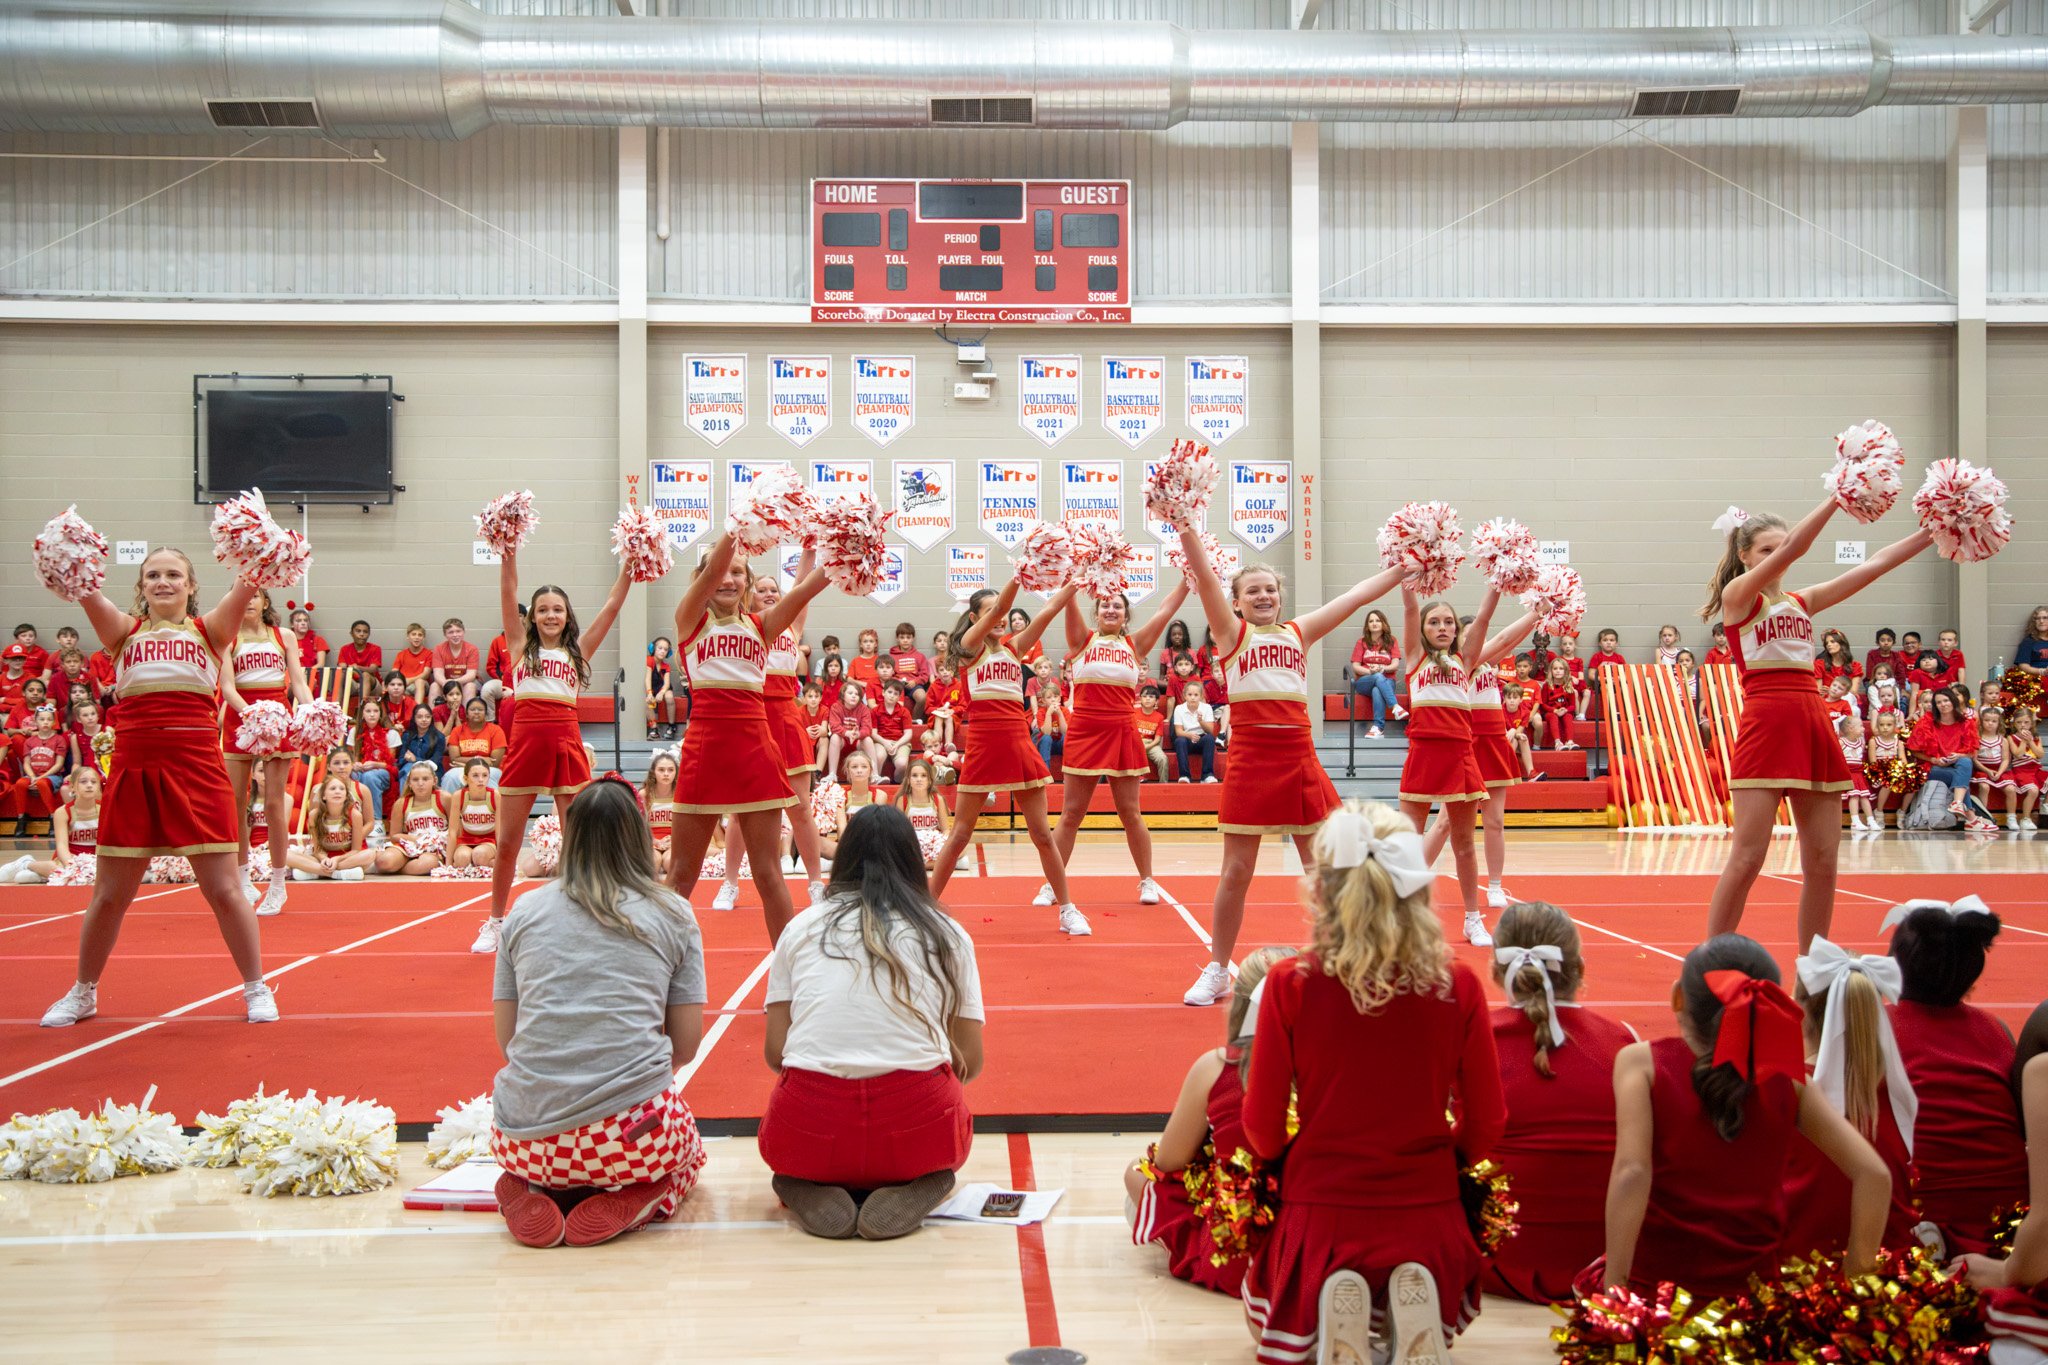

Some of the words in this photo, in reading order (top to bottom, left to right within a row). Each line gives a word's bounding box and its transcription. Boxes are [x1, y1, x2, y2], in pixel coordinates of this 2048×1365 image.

[824, 185, 878, 203] HOME
[1060, 186, 1120, 204] GUEST
[944, 233, 978, 244] PERIOD
[824, 254, 854, 264] FOULS
[885, 255, 909, 265] T.O.L.
[938, 255, 972, 265] PLAYER
[981, 255, 1005, 265] FOUL
[1034, 256, 1058, 266] T.O.L.
[1088, 256, 1118, 265] FOULS
[824, 292, 854, 302] SCORE
[955, 292, 987, 302] MATCH
[1088, 292, 1118, 302] SCORE
[817, 309, 883, 322] Scoreboard
[886, 309, 936, 322] Donated
[938, 310, 953, 323] by
[956, 310, 996, 322] Electra
[998, 310, 1074, 322] Construction
[1076, 310, 1100, 323] Co.,
[1102, 310, 1124, 322] Inc.
[689, 392, 705, 404] SAND
[706, 392, 744, 404] VOLLEYBALL
[774, 394, 826, 405] VOLLEYBALL
[857, 394, 910, 404] VOLLEYBALL
[1024, 394, 1076, 404] VOLLEYBALL
[1107, 394, 1160, 406] BASKETBALL
[1190, 394, 1208, 404] GIRLS
[1209, 394, 1243, 404] ATHLETICS
[689, 404, 743, 416] CHAMPIONS
[774, 404, 826, 416] CHAMPION
[856, 404, 910, 416] CHAMPION
[1024, 404, 1076, 416] CHAMPION
[1107, 406, 1160, 417] RUNNERUP
[1190, 404, 1243, 416] CHAMPION
[703, 420, 730, 430] 2018
[796, 417, 807, 426] 1A
[869, 418, 898, 428] 2020
[1036, 418, 1064, 428] 2021
[1120, 420, 1146, 430] 2021
[1203, 419, 1230, 428] 2021
[790, 426, 812, 435] 2018
[655, 498, 708, 509] VOLLEYBALL
[984, 498, 1036, 508] TENNIS
[1066, 498, 1118, 509] VOLLEYBALL
[1246, 500, 1276, 510] GOLF
[655, 509, 708, 520] CHAMPION
[983, 509, 1036, 520] CHAMPION
[1066, 509, 1118, 520] CHAMPION
[1234, 510, 1286, 522] CHAMPION
[1301, 475, 1314, 560] WARRIORS
[897, 516, 950, 528] CHAMPION
[996, 522, 1024, 532] 2023
[668, 524, 696, 532] 2022
[1247, 524, 1274, 534] 2025
[1004, 534, 1016, 542] 1A
[1256, 536, 1266, 544] 1A
[950, 582, 984, 590] CHAMPION
[1754, 615, 1813, 647] WARRIOR
[123, 640, 208, 671] WARRIORS
[696, 634, 765, 671] WARRIORS
[234, 652, 284, 672] WARRIORS
[1084, 648, 1134, 670] WARRIORS
[1238, 644, 1306, 678] WARRIORS
[517, 659, 577, 688] WARIORS
[976, 662, 1020, 684] WARRIOR
[1418, 666, 1468, 693] WARORS
[462, 814, 496, 824] WARRIORS
[650, 810, 672, 822] ARRIO
[912, 816, 938, 827] RRIORS
[69, 828, 98, 843] ARRIO
[327, 832, 352, 844] RRIORS
